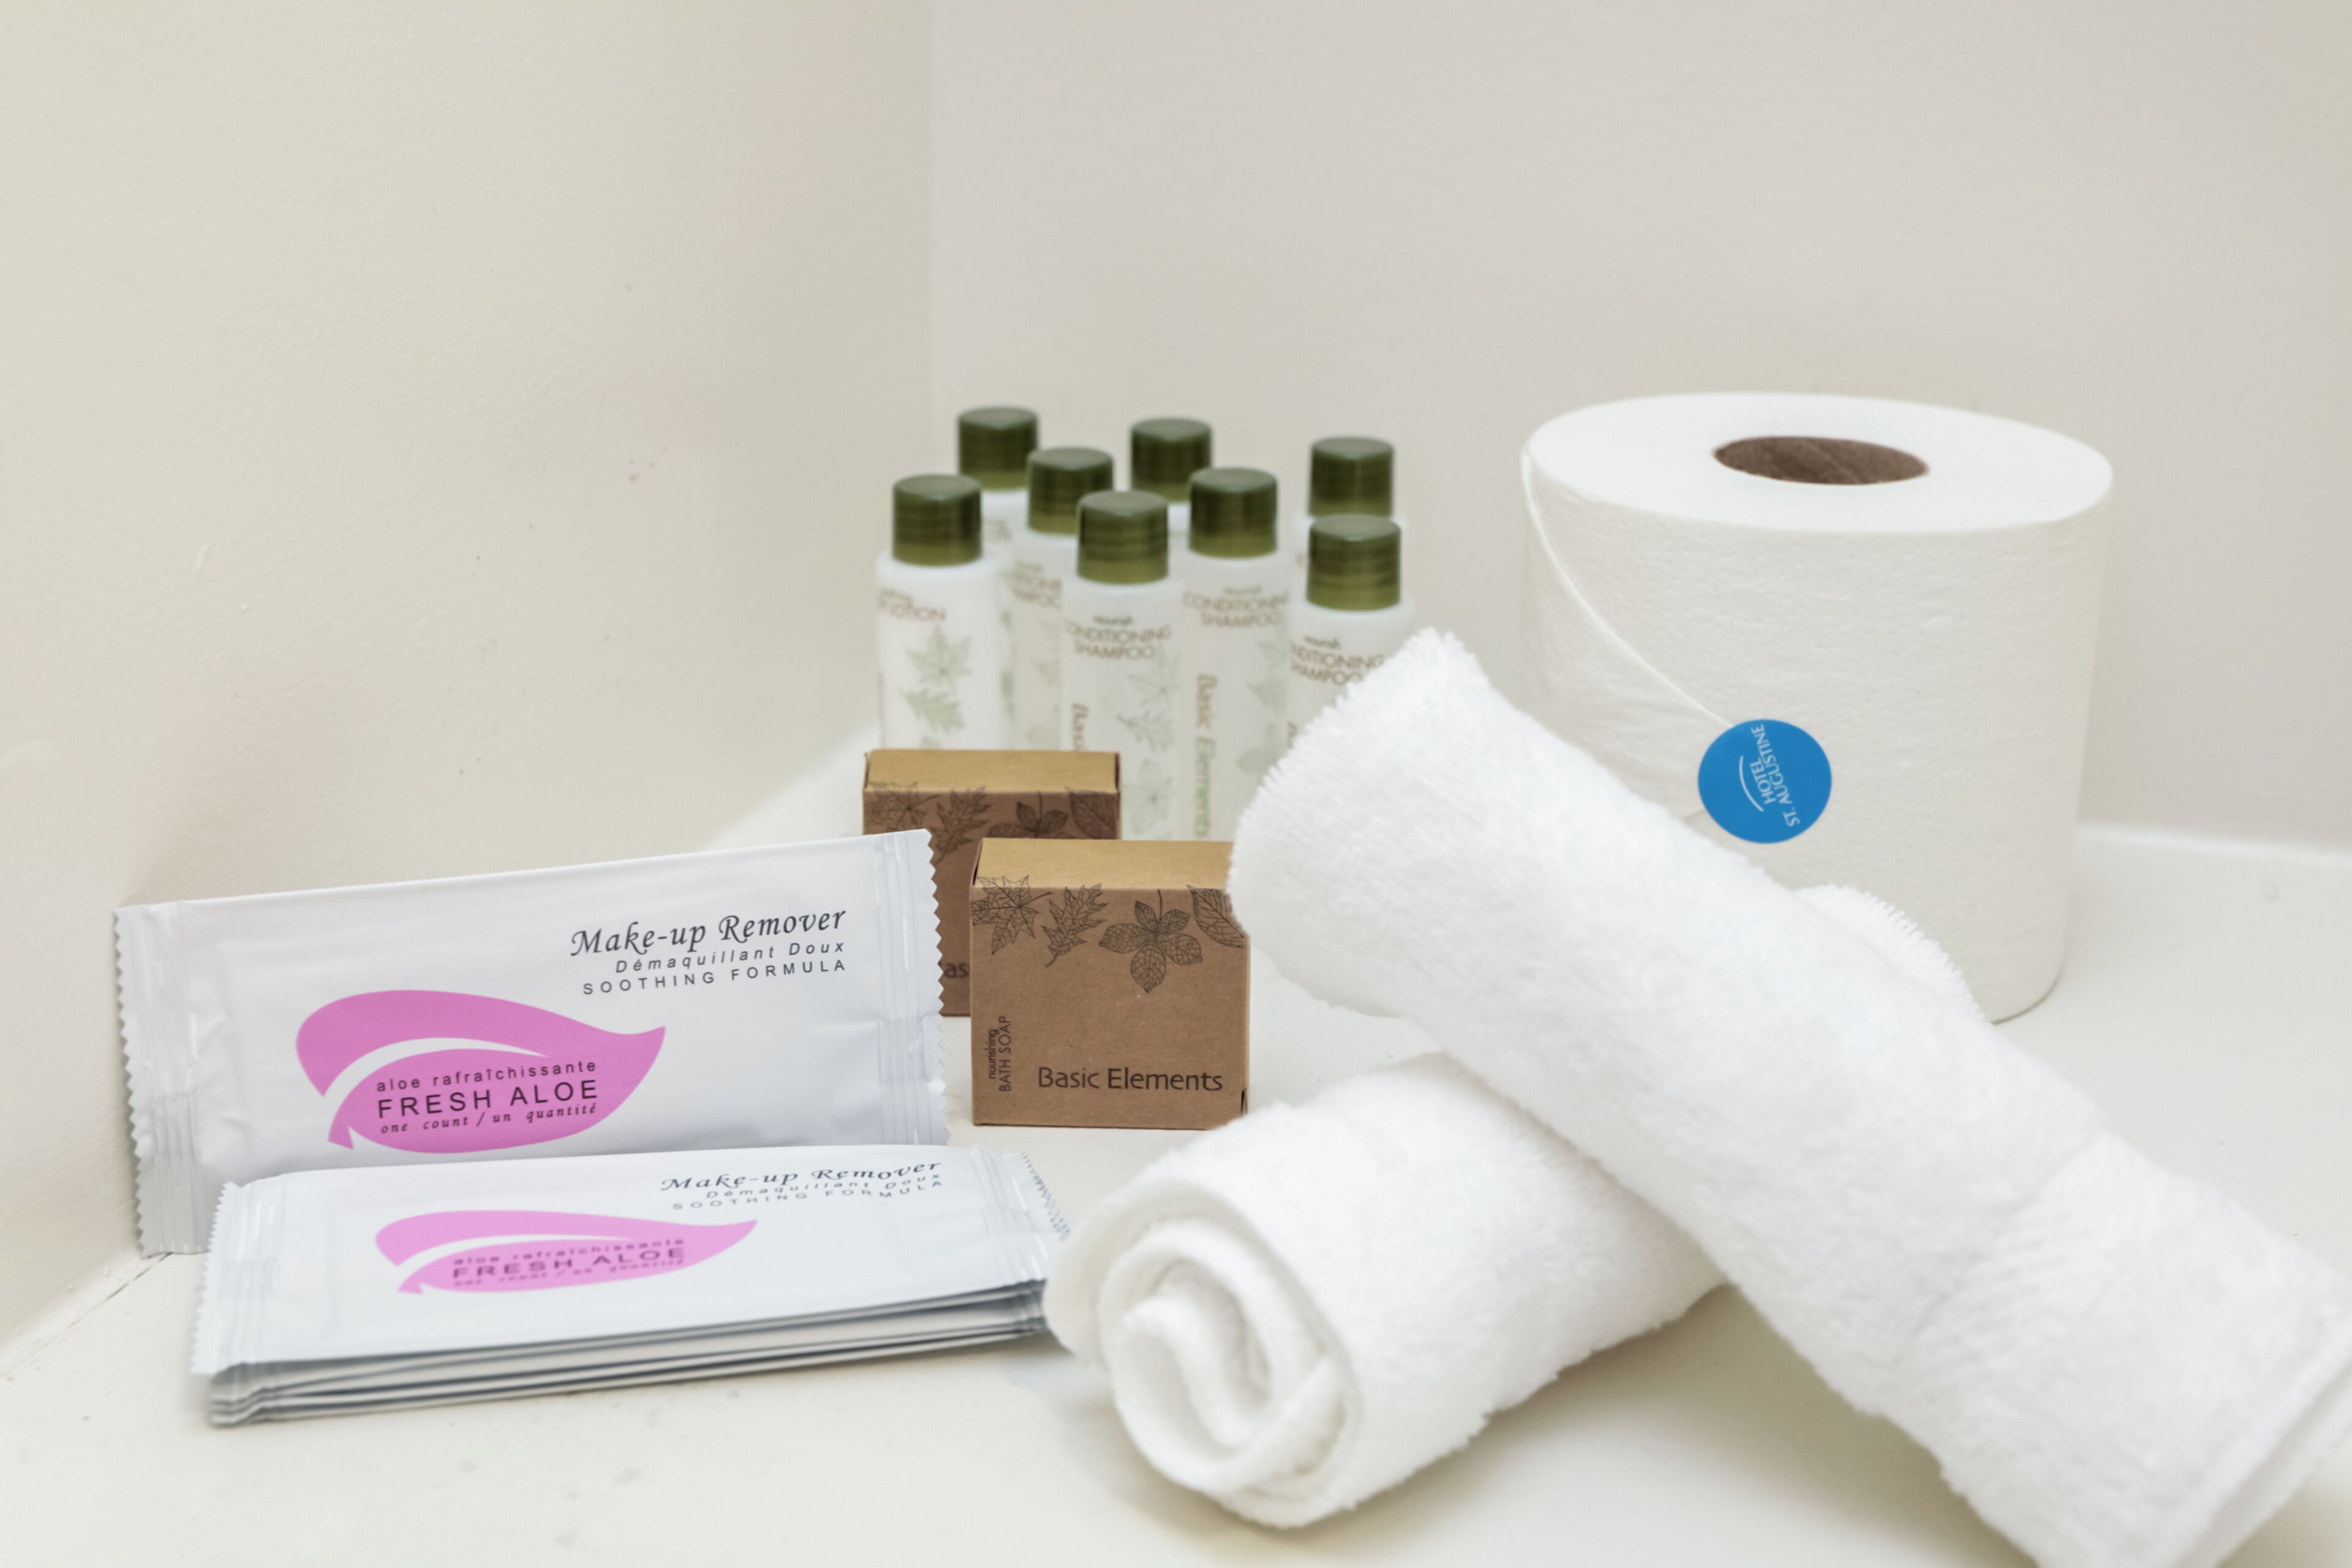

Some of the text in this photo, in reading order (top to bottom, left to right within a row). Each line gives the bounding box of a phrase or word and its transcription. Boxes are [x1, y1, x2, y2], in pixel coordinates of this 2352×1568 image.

[1749, 757, 1776, 804] HOTEL
[1751, 724, 1793, 805] AUGUSTINE
[570, 910, 846, 956] Make-up Remover
[616, 942, 844, 973] Démaquillant Doux
[583, 960, 845, 995] SOOTHING FORMULA
[984, 1029, 999, 1079] nourishing
[998, 1016, 1012, 1091] BATH SOAP
[377, 1061, 597, 1092] aloe rafraîchissante
[1038, 1068, 1223, 1091] Basic Elements
[377, 1079, 598, 1118] FRESH ALOE
[380, 1122, 408, 1134] one
[423, 1117, 470, 1130] count
[492, 1114, 512, 1123] un
[526, 1102, 597, 1123] quantité
[660, 1163, 943, 1191] Make-up Remover
[672, 1181, 943, 1210] SOOTHING FORMULA
[453, 1247, 685, 1278] FRESH ALOE
